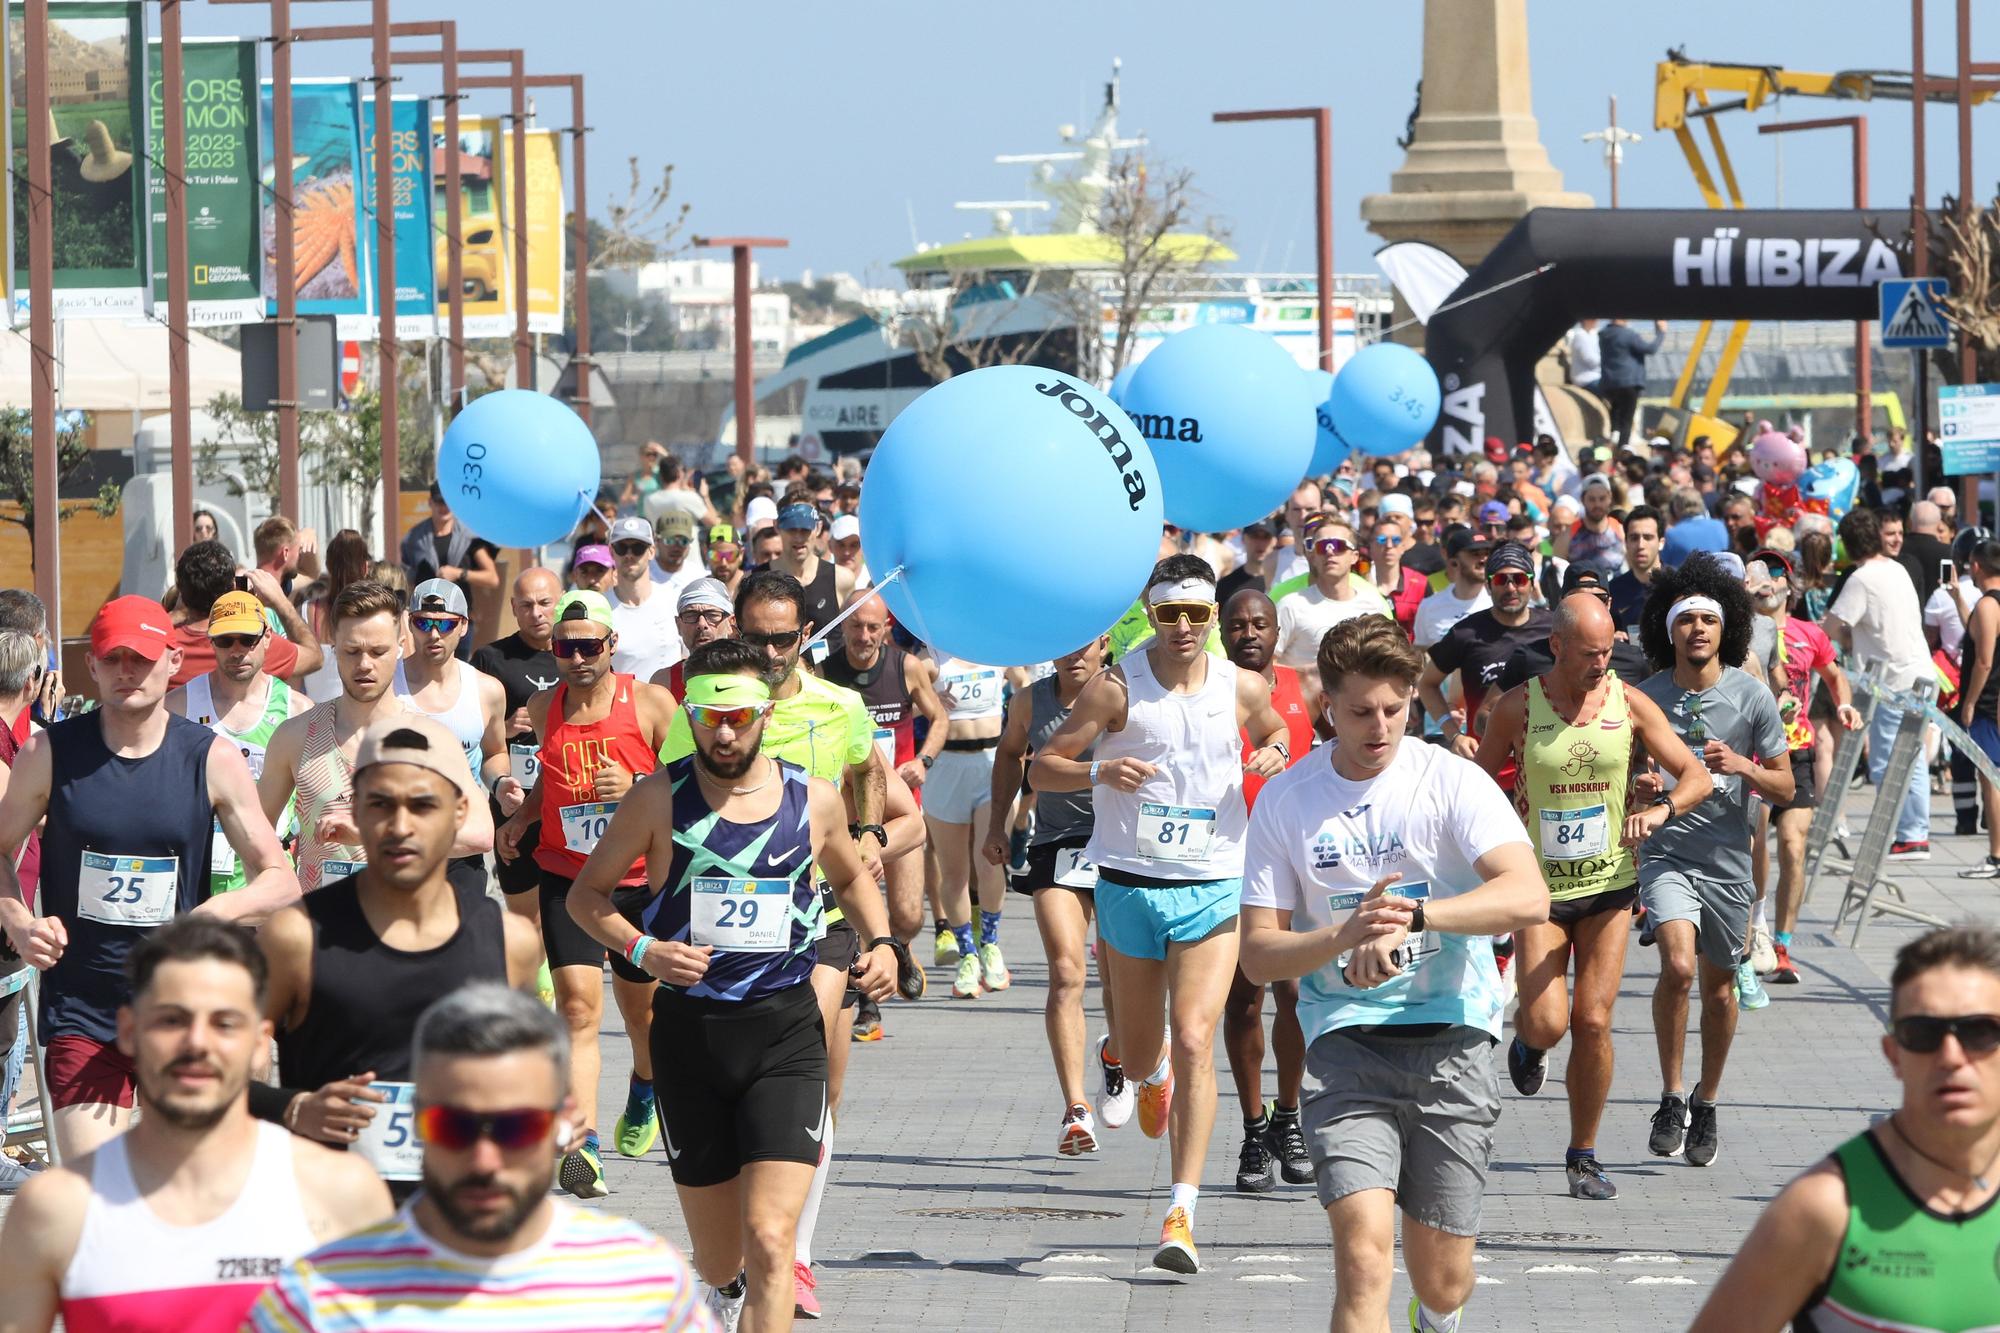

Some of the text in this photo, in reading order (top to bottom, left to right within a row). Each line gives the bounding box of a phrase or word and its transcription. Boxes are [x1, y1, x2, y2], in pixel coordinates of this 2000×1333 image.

[186, 103, 248, 128] MÓN
[1673, 227, 1904, 287] HÏ IBIZA
[1388, 384, 1425, 420] 3:45
[836, 404, 880, 426] AIRE
[1125, 410, 1203, 443] ma
[1035, 379, 1147, 512] Joma
[462, 443, 487, 500] 3:30
[961, 683, 982, 701] 26
[1550, 782, 1610, 794] VSK NOSKRIEN
[1158, 821, 1190, 845] 81
[1344, 832, 1404, 856] IBIZA
[1557, 823, 1585, 845] 84
[102, 876, 145, 904] 25
[704, 882, 723, 890] IBIZA
[716, 899, 759, 929] 29
